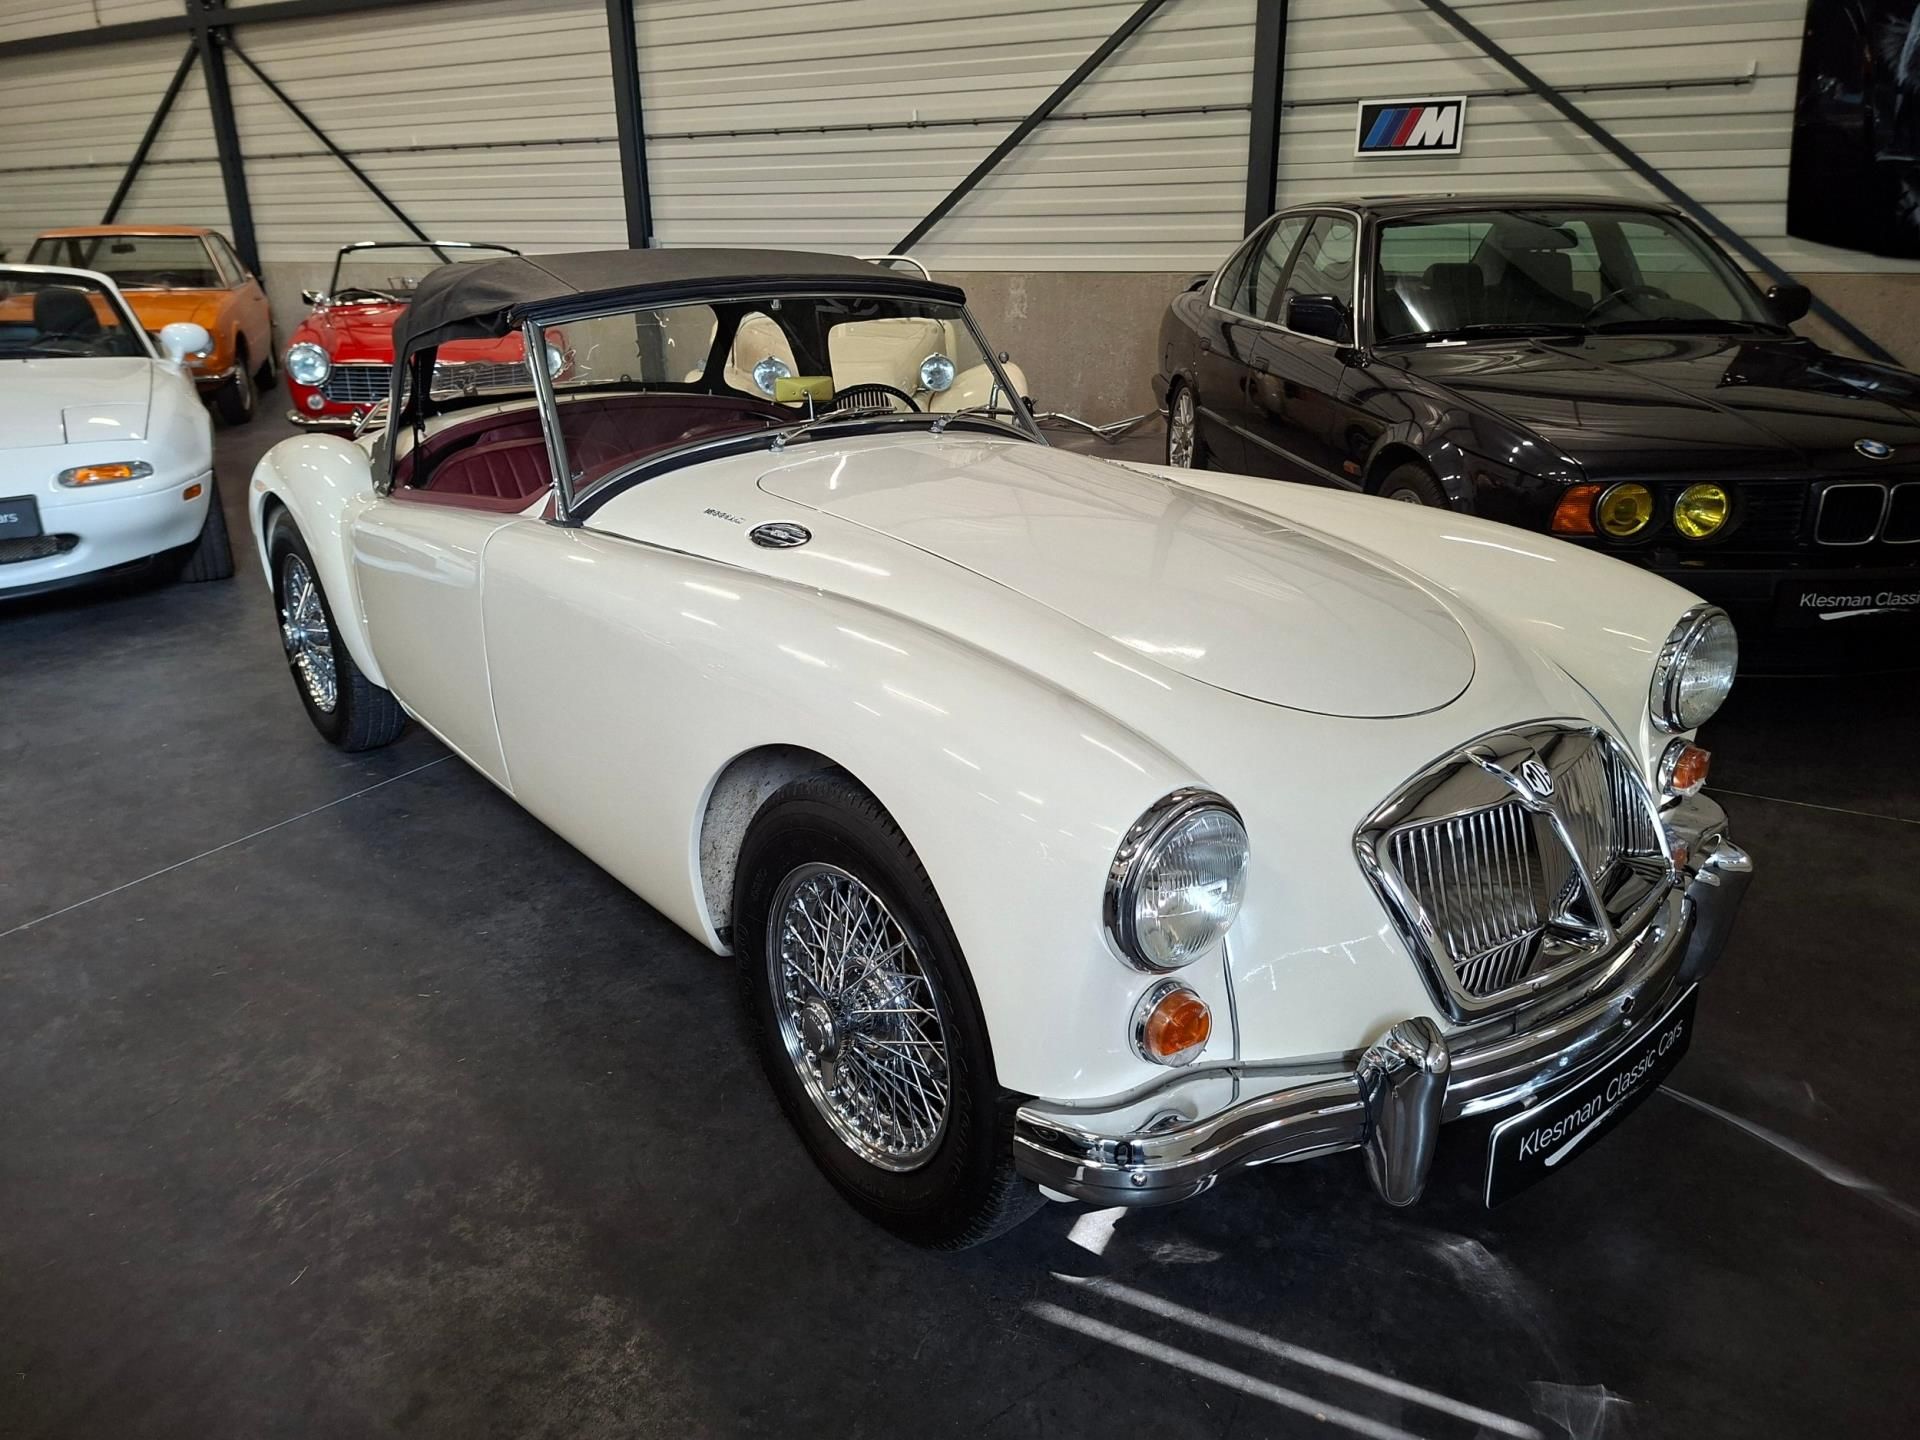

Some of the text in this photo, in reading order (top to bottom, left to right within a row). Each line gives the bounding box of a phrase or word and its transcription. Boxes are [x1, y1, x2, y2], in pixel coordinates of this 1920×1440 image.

[1800, 592, 1872, 607] Klesman
[1525, 761, 1553, 794] MG
[1519, 1019, 1683, 1161] Klesman Classic Cars
